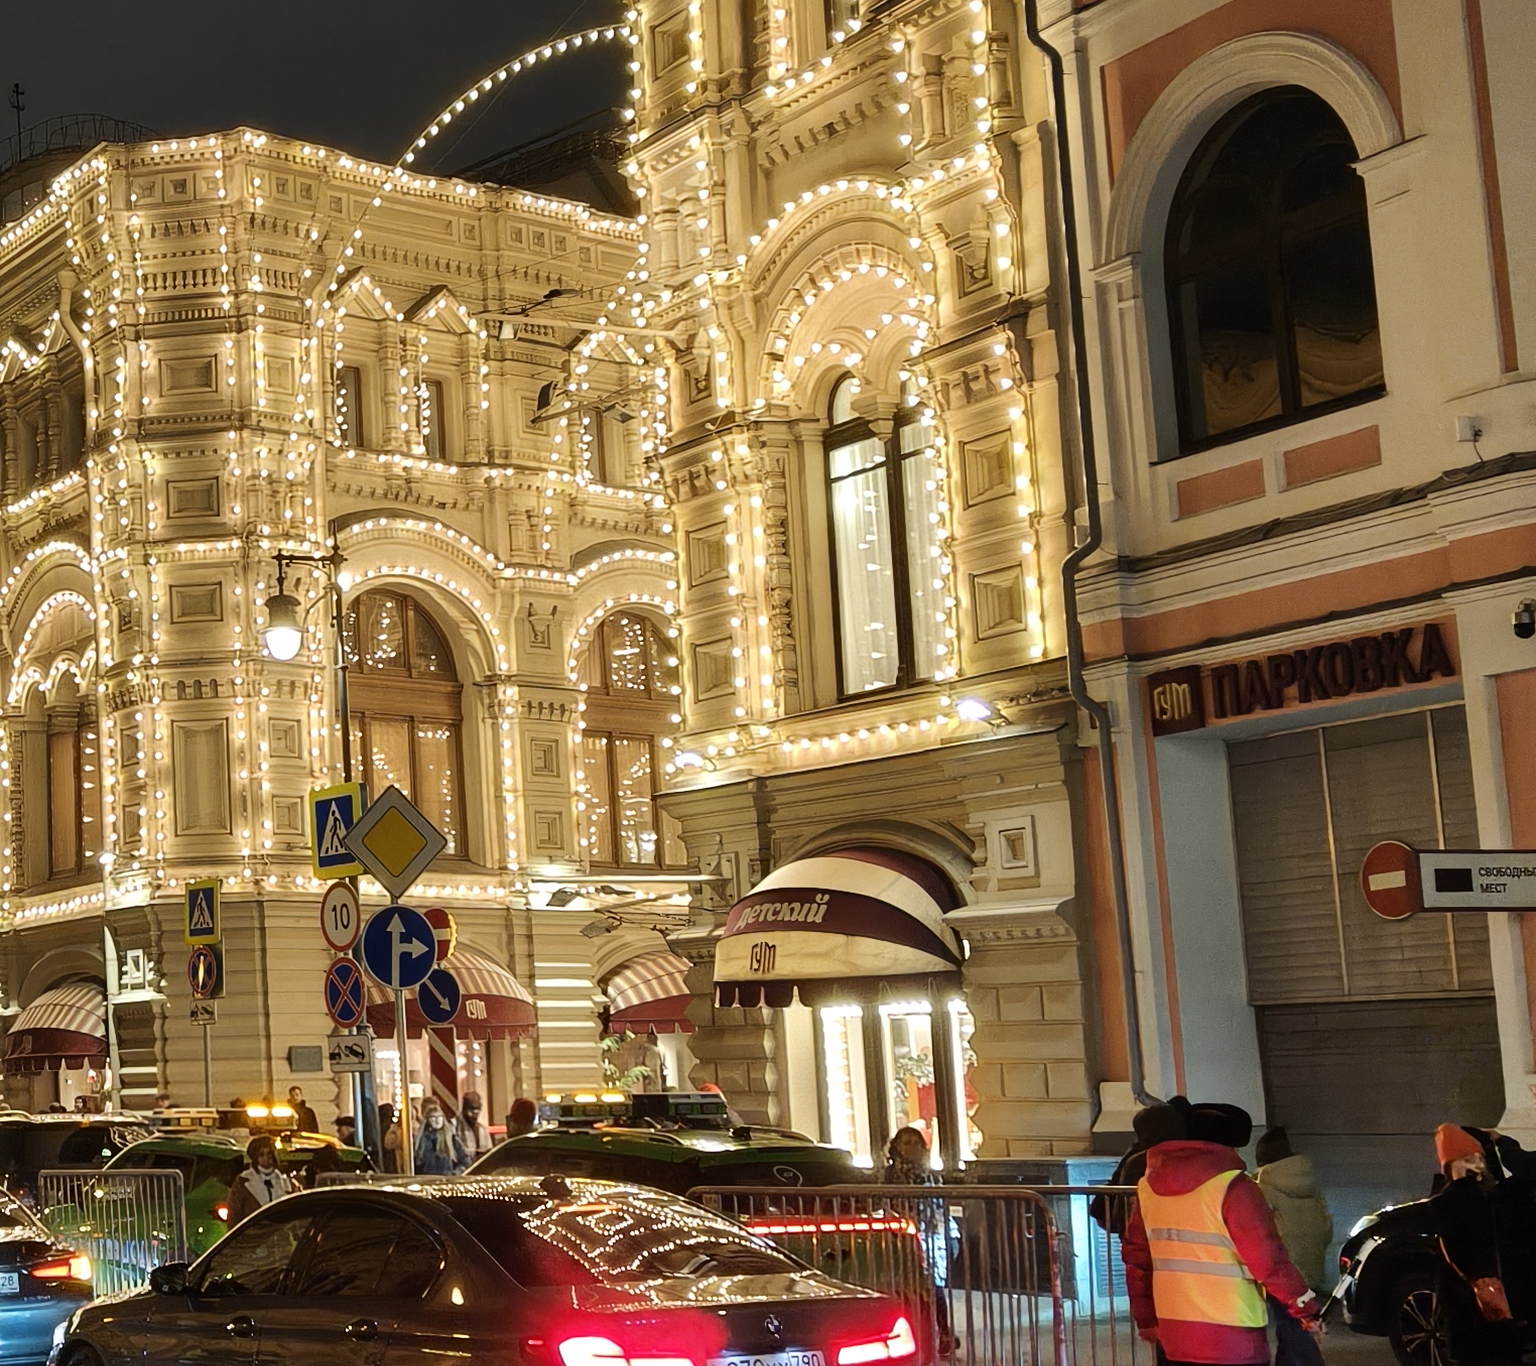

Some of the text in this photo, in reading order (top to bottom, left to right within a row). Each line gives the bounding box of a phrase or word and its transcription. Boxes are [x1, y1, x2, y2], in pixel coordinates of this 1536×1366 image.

[1153, 623, 1456, 720] ГУМ ПАРКОВКА
[1478, 866, 1536, 879] СВОБОДНЫ
[1480, 883, 1507, 893] МЕСТ
[331, 903, 350, 931] 10
[749, 941, 777, 975] ГУМ
[465, 999, 488, 1020] ГУМ
